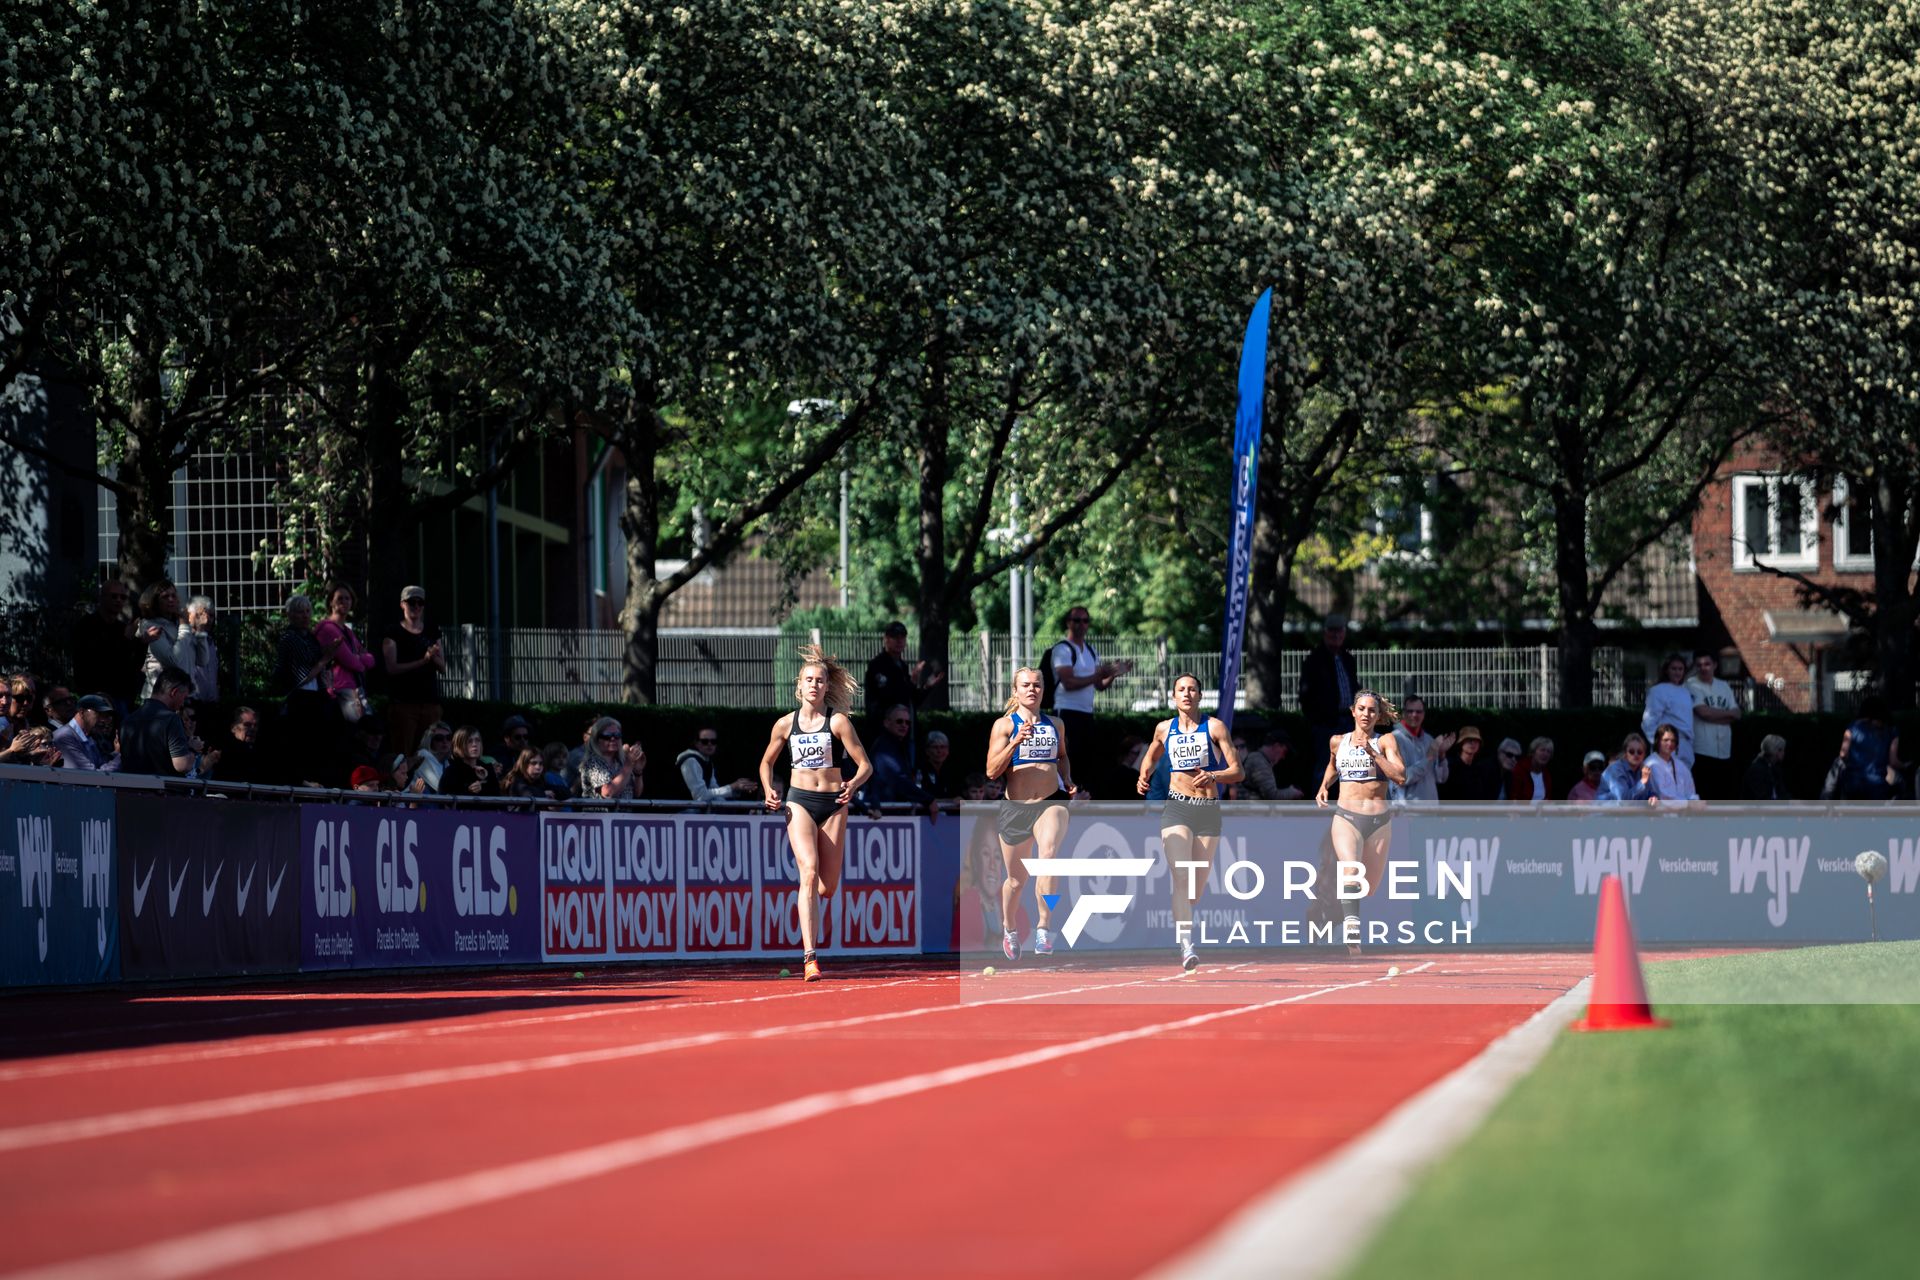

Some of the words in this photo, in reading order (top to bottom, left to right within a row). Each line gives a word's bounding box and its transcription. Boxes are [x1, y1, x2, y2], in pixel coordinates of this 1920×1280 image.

[799, 735, 819, 744] GLS
[1173, 745, 1202, 758] KEMP
[1177, 735, 1195, 744] GLS
[1341, 759, 1374, 768] BRUNNER
[1168, 790, 1185, 801] PRO
[547, 824, 602, 884] LIQUI
[614, 825, 673, 885] LIQUI
[687, 825, 748, 884] LIQUI
[845, 827, 912, 883] LIQUI
[1506, 859, 1563, 876] Versicherung
[1659, 858, 1718, 876] Versicherung
[547, 891, 604, 949] MOLY
[616, 891, 675, 948] MOLY
[687, 890, 752, 947] MOLY
[764, 889, 829, 946] MOY
[845, 889, 914, 943] MOLY
[1146, 909, 1248, 928] INTEATIONAL
[376, 927, 394, 950] Parcels
[401, 925, 419, 955] People
[455, 931, 477, 951] Parcels
[479, 933, 486, 950] to
[487, 928, 509, 957] People
